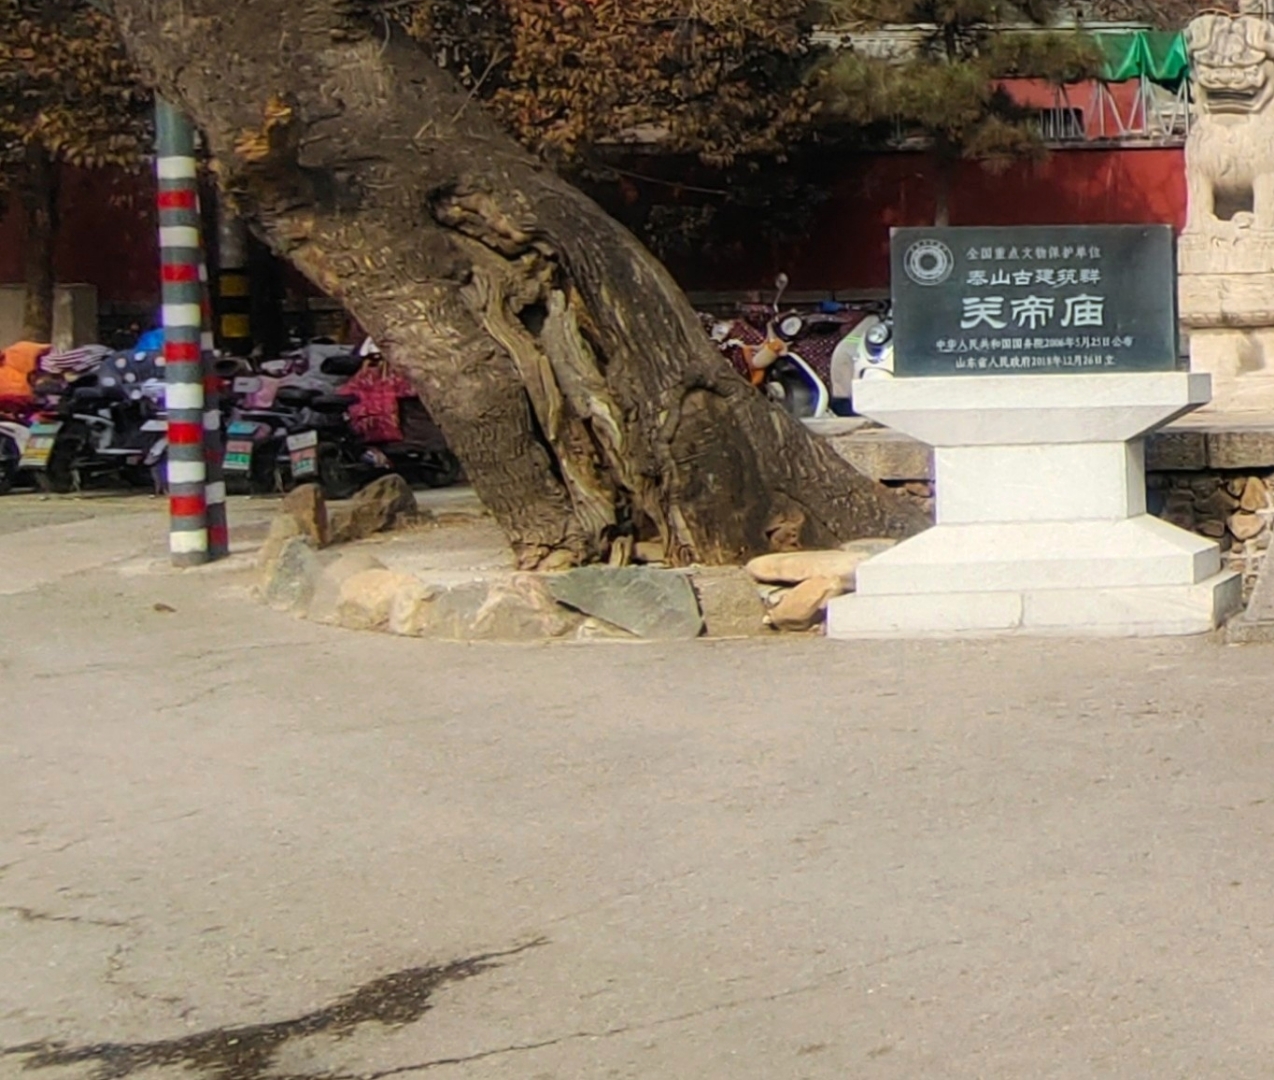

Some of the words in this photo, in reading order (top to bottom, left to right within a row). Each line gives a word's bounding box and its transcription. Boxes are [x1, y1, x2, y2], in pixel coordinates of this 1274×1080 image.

[965, 246, 1102, 261] 全国重点文物保护单位
[965, 268, 1102, 289] 泰山古建筑群
[960, 293, 1107, 331] 关帝庙
